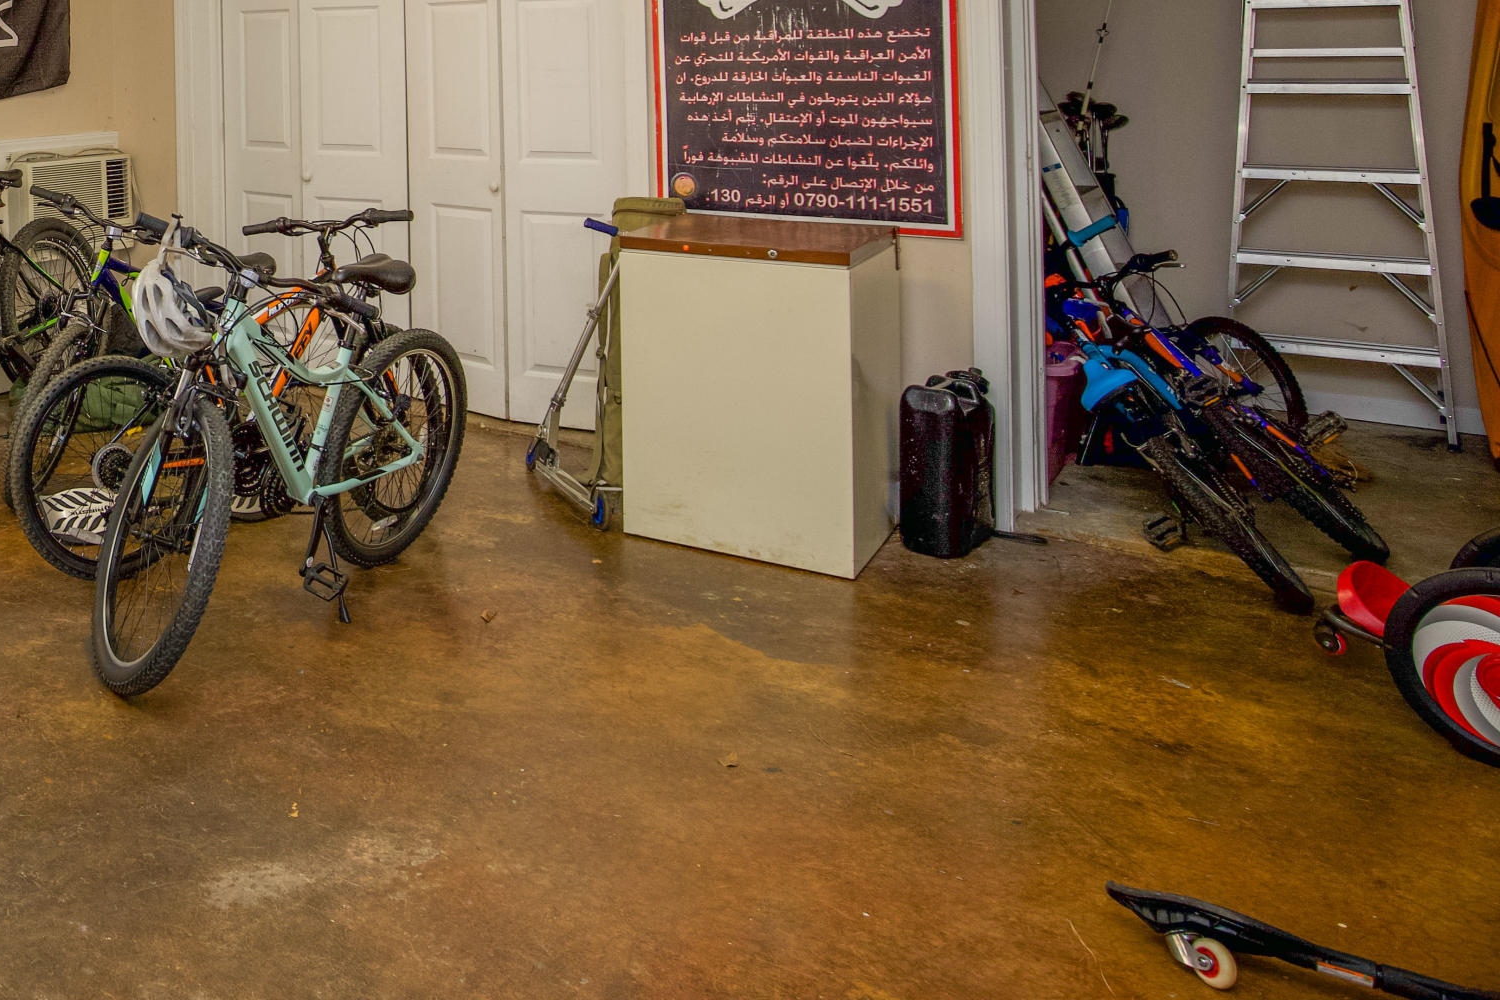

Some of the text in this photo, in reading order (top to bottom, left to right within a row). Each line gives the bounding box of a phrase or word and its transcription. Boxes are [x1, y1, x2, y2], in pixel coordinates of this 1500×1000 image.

[680, 31, 707, 45] قوات
[709, 31, 731, 45] قبل
[733, 34, 750, 44] من
[806, 28, 854, 40] المنطقة
[857, 28, 883, 38] هذه
[886, 27, 931, 43] تخضع
[674, 55, 691, 65] عن
[737, 47, 790, 65] الأمريكية
[793, 49, 840, 64] والقوات
[843, 48, 895, 64] العراقية
[898, 45, 931, 63] الأمن
[731, 71, 768, 85] الخارقة
[771, 71, 822, 85] والعبوات
[826, 70, 878, 82] الناسفة
[881, 70, 932, 85] العبوات
[726, 91, 784, 102] النشاطات
[787, 91, 806, 108] في
[808, 92, 859, 106] يتورطون
[861, 92, 895, 106] الذين
[898, 91, 933, 107] هؤلاء
[687, 112, 709, 122] هذه
[815, 109, 826, 127] أو
[829, 113, 858, 127] الموت
[861, 113, 933, 128] سيواجهون
[767, 133, 826, 147] سلامتكم
[829, 135, 873, 148] لضمان
[876, 135, 933, 151] الإجراءات
[707, 152, 759, 166] المشبوهة
[761, 153, 821, 165] النشاطات
[825, 159, 844, 169] عن
[801, 176, 827, 189] على
[830, 177, 877, 193] الإتصال
[880, 178, 911, 192] خلال
[914, 183, 935, 194] من
[745, 194, 776, 208] الرقم
[780, 192, 790, 209] أو
[793, 192, 933, 214] 0790-111-1551
